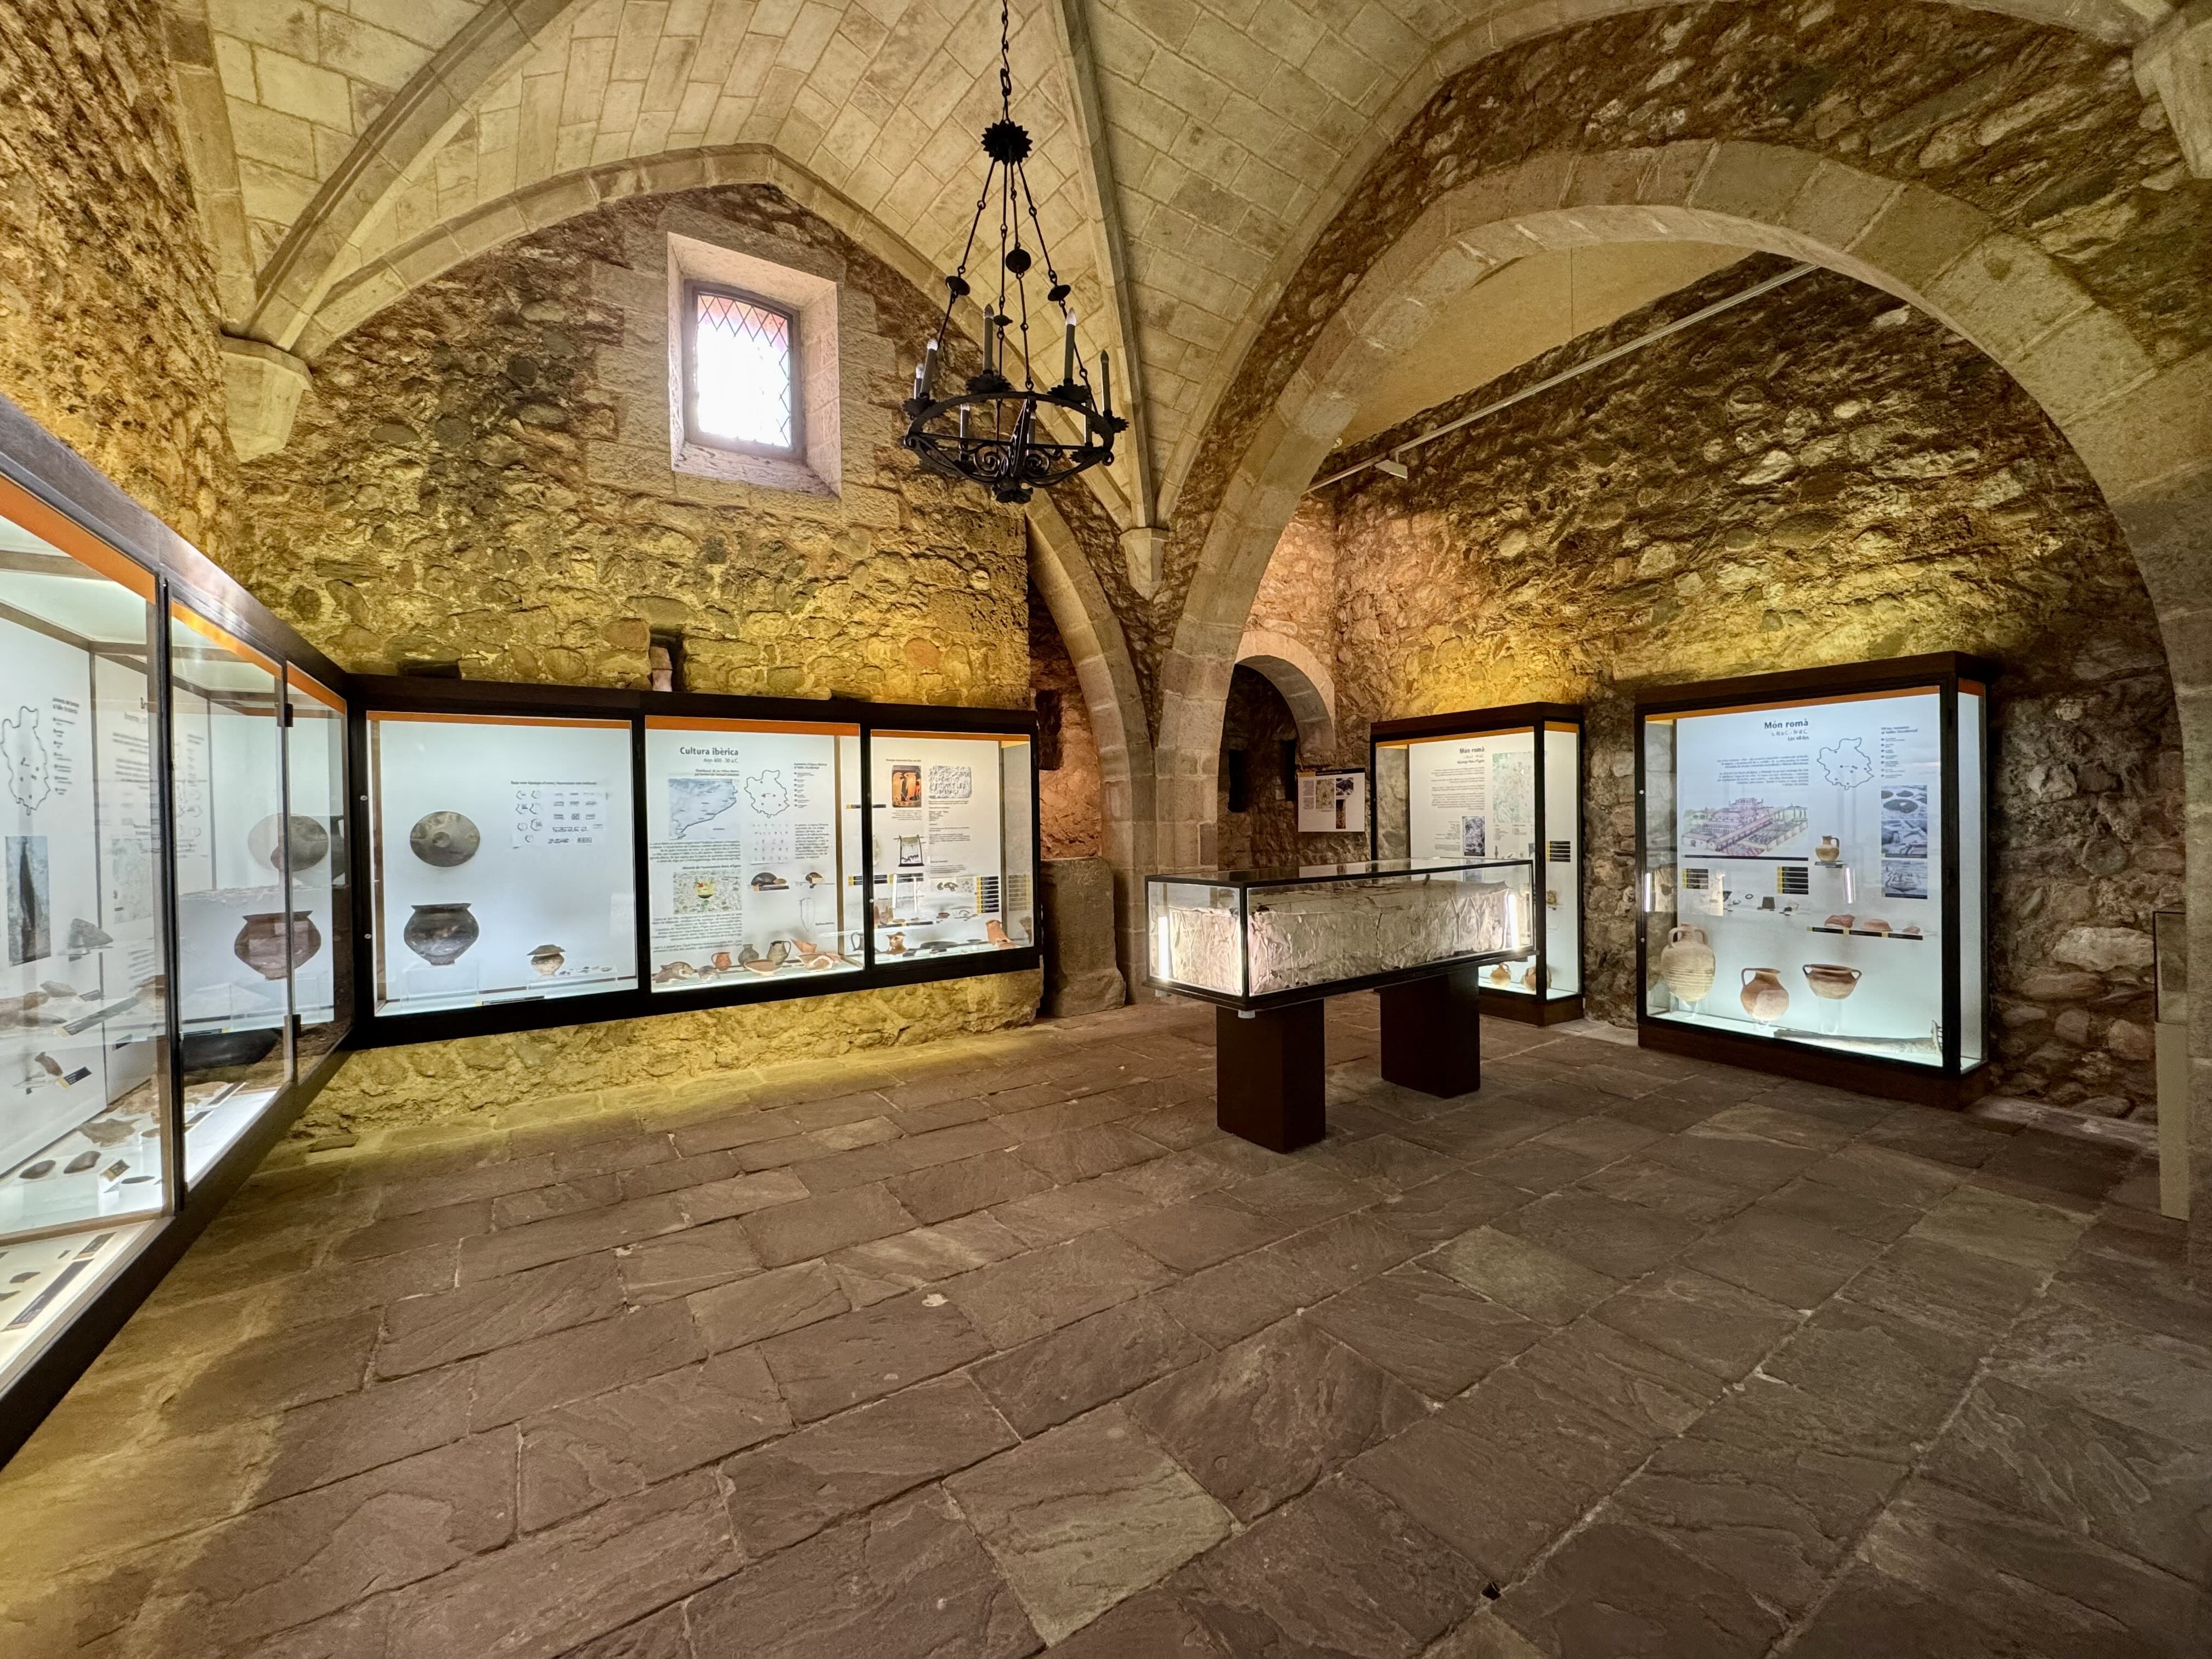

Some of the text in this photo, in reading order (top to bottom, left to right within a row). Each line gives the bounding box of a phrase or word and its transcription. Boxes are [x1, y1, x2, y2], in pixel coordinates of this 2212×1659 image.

[1764, 718, 1808, 729] Món romà
[680, 747, 738, 755] Cultura ibèrica
